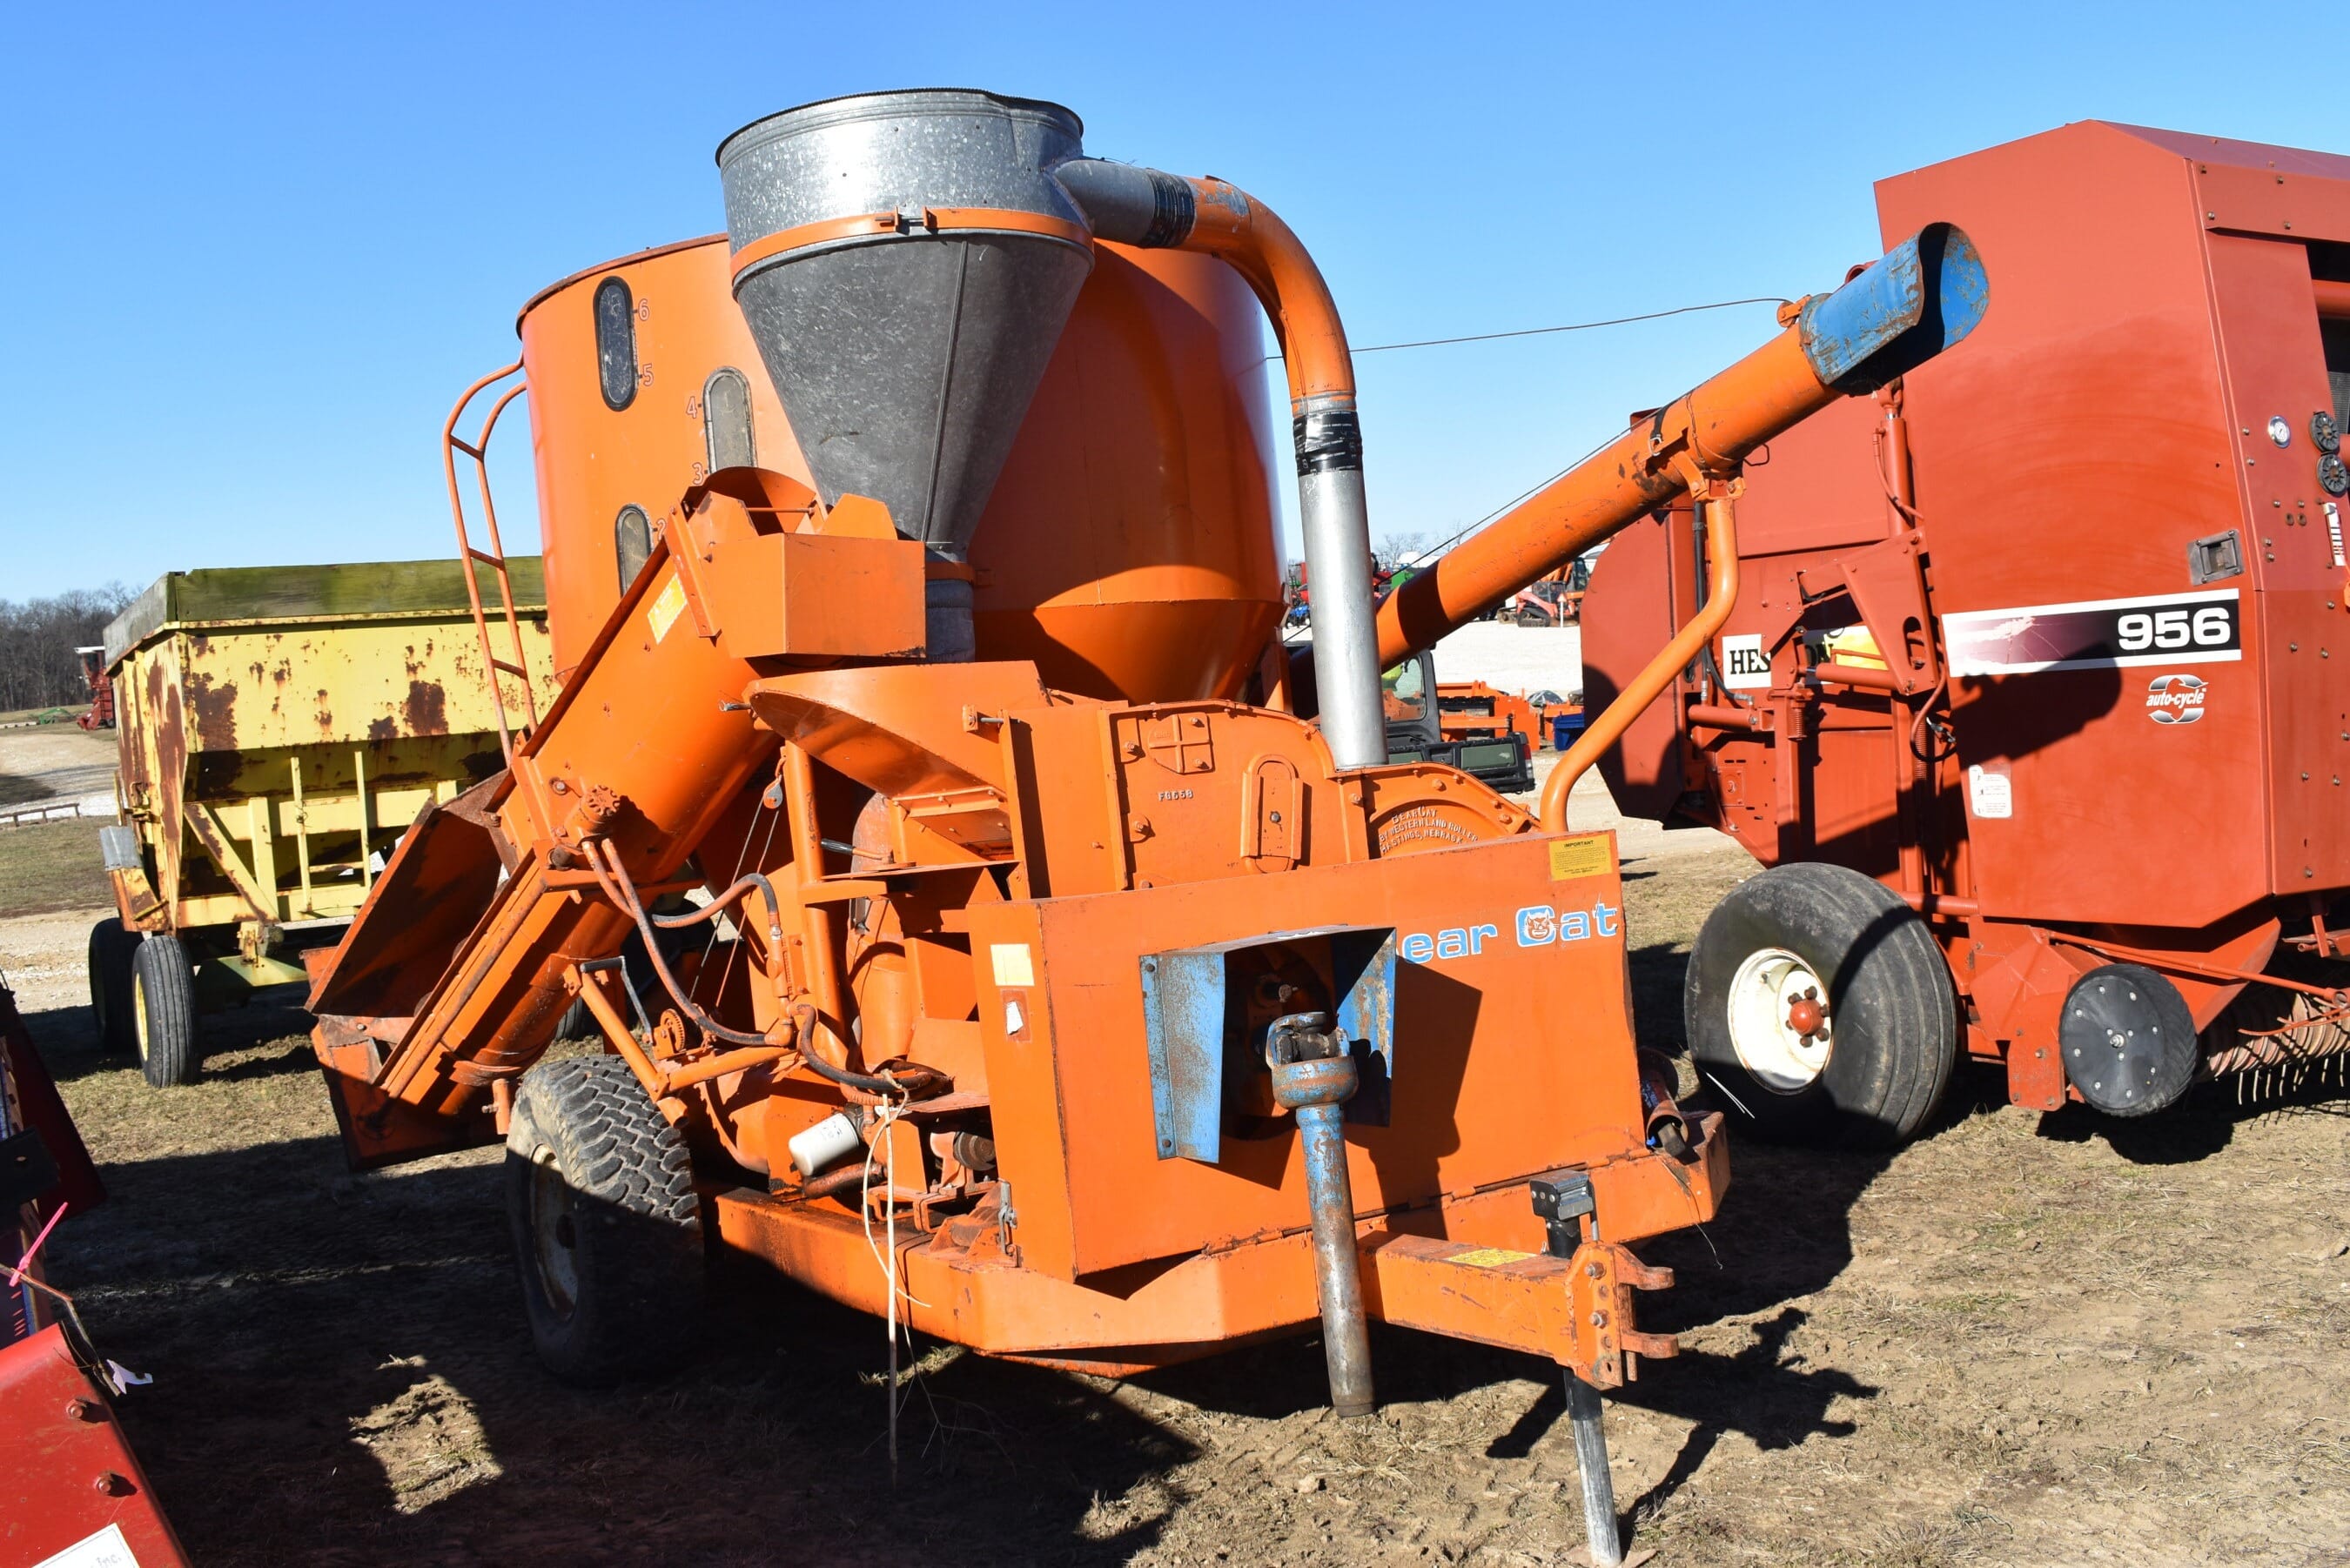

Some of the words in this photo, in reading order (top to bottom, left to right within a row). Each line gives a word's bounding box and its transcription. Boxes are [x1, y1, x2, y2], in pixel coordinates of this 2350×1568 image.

[637, 298, 650, 321] 6
[642, 363, 655, 387] 5
[686, 395, 698, 419] 4
[692, 462, 704, 486] 3
[655, 518, 667, 541] 2
[2117, 607, 2231, 651] 956
[2145, 688, 2206, 709] auto-cycle
[1391, 818, 1426, 835] WESTERN
[1427, 819, 1447, 829] LAND
[1448, 821, 1479, 842] ROLLER
[1564, 840, 1594, 848] IMPORTANT
[1396, 922, 1498, 965] ear
